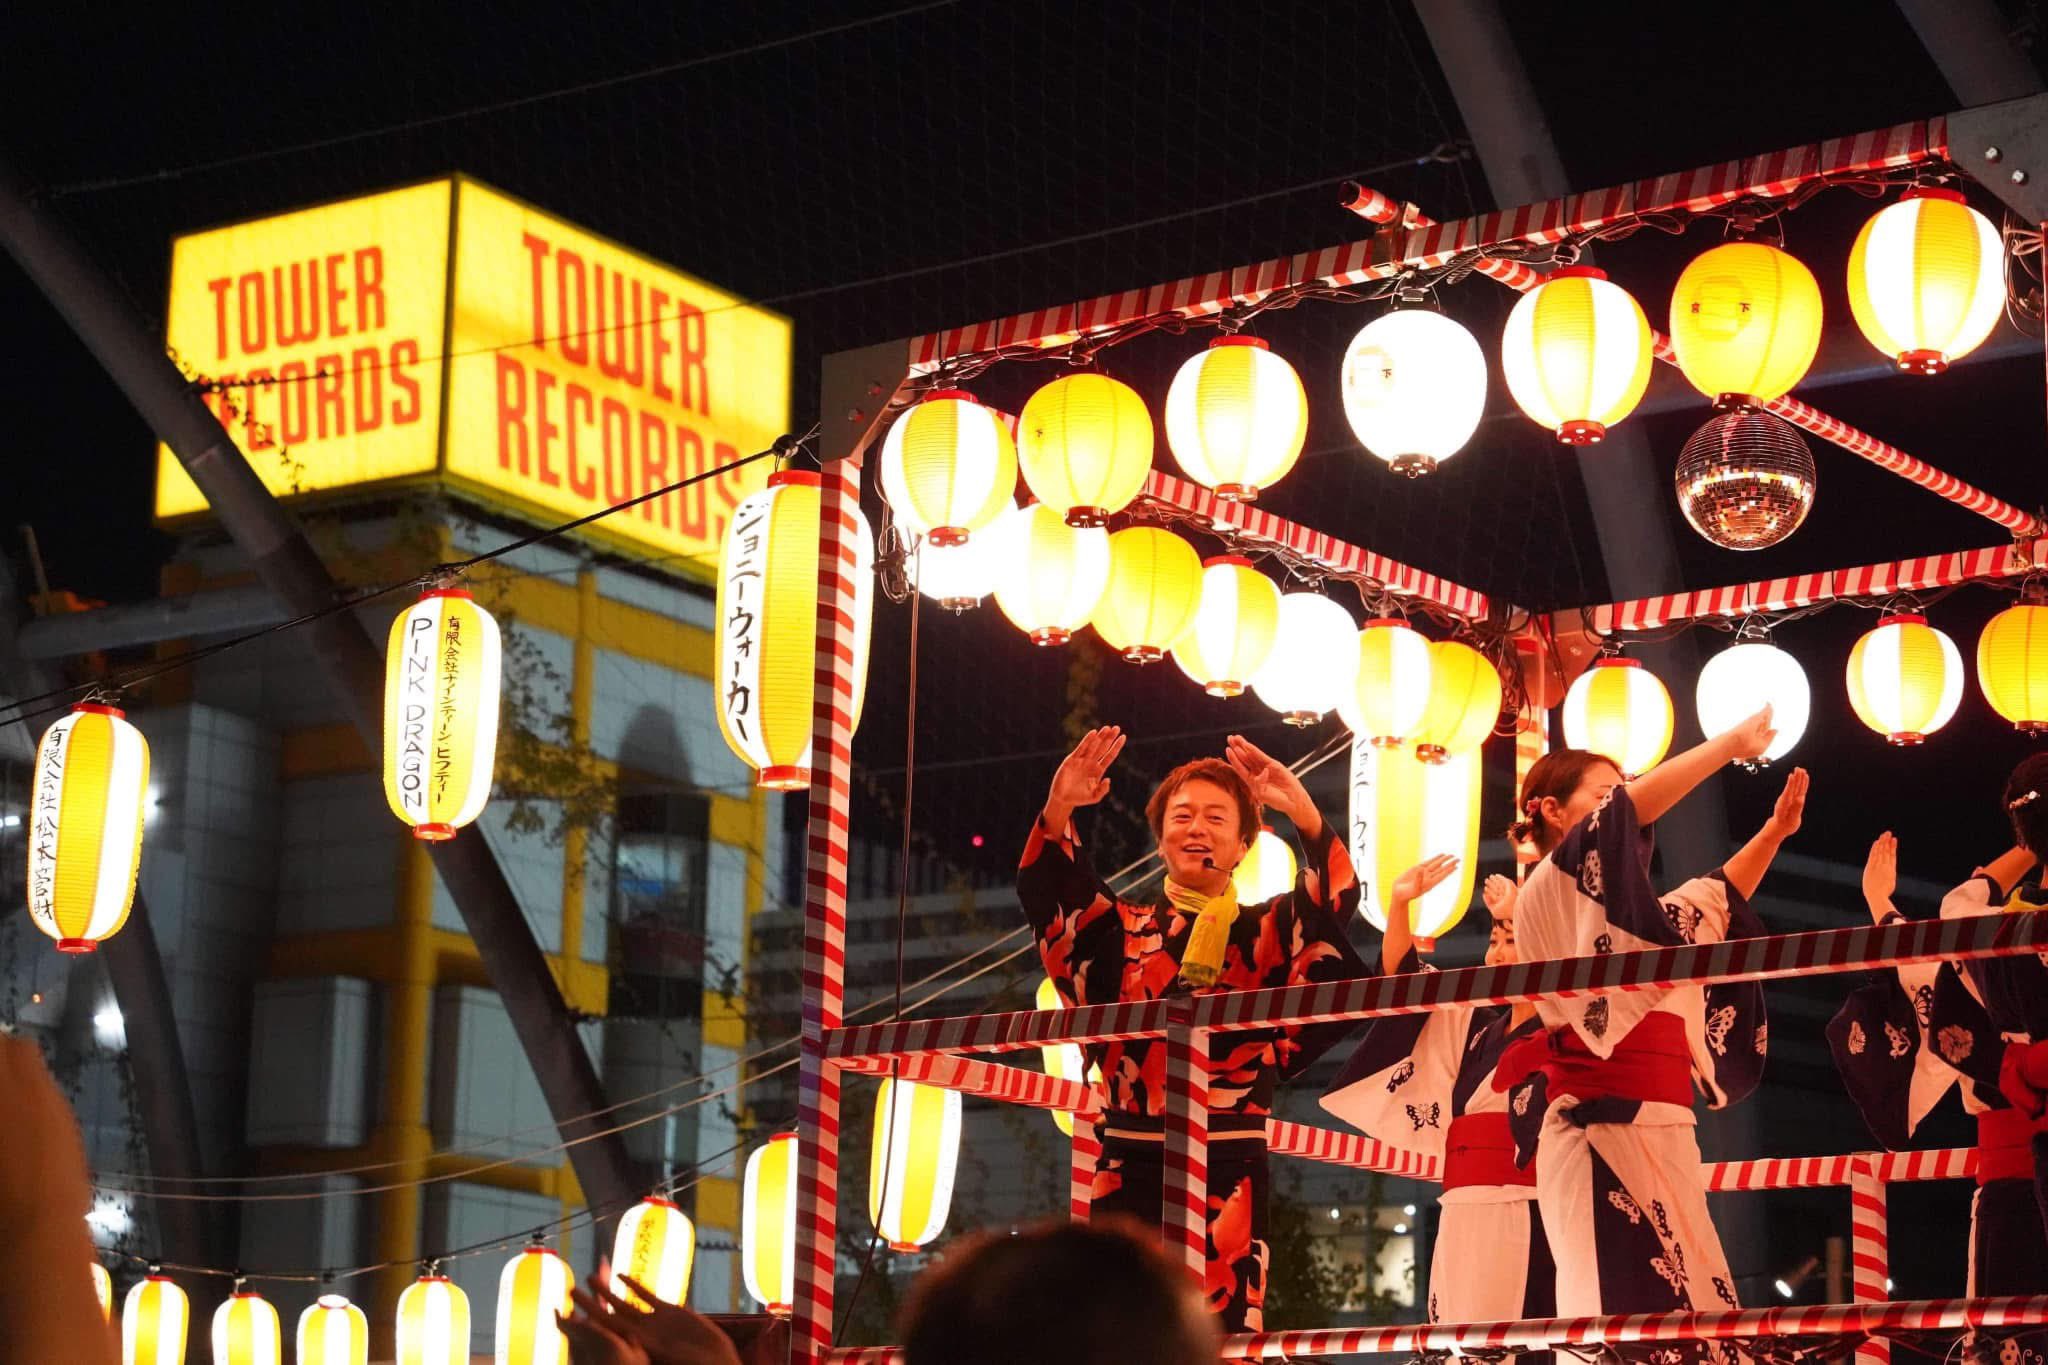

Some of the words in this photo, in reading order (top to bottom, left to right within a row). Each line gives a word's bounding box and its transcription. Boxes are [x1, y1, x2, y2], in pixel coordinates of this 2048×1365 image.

[208, 246, 386, 361] TOWER
[523, 232, 710, 418] TOWER
[408, 617, 433, 694] PINK
[726, 501, 770, 742] ジョニーウォーカー
[402, 704, 426, 809] DRAGON
